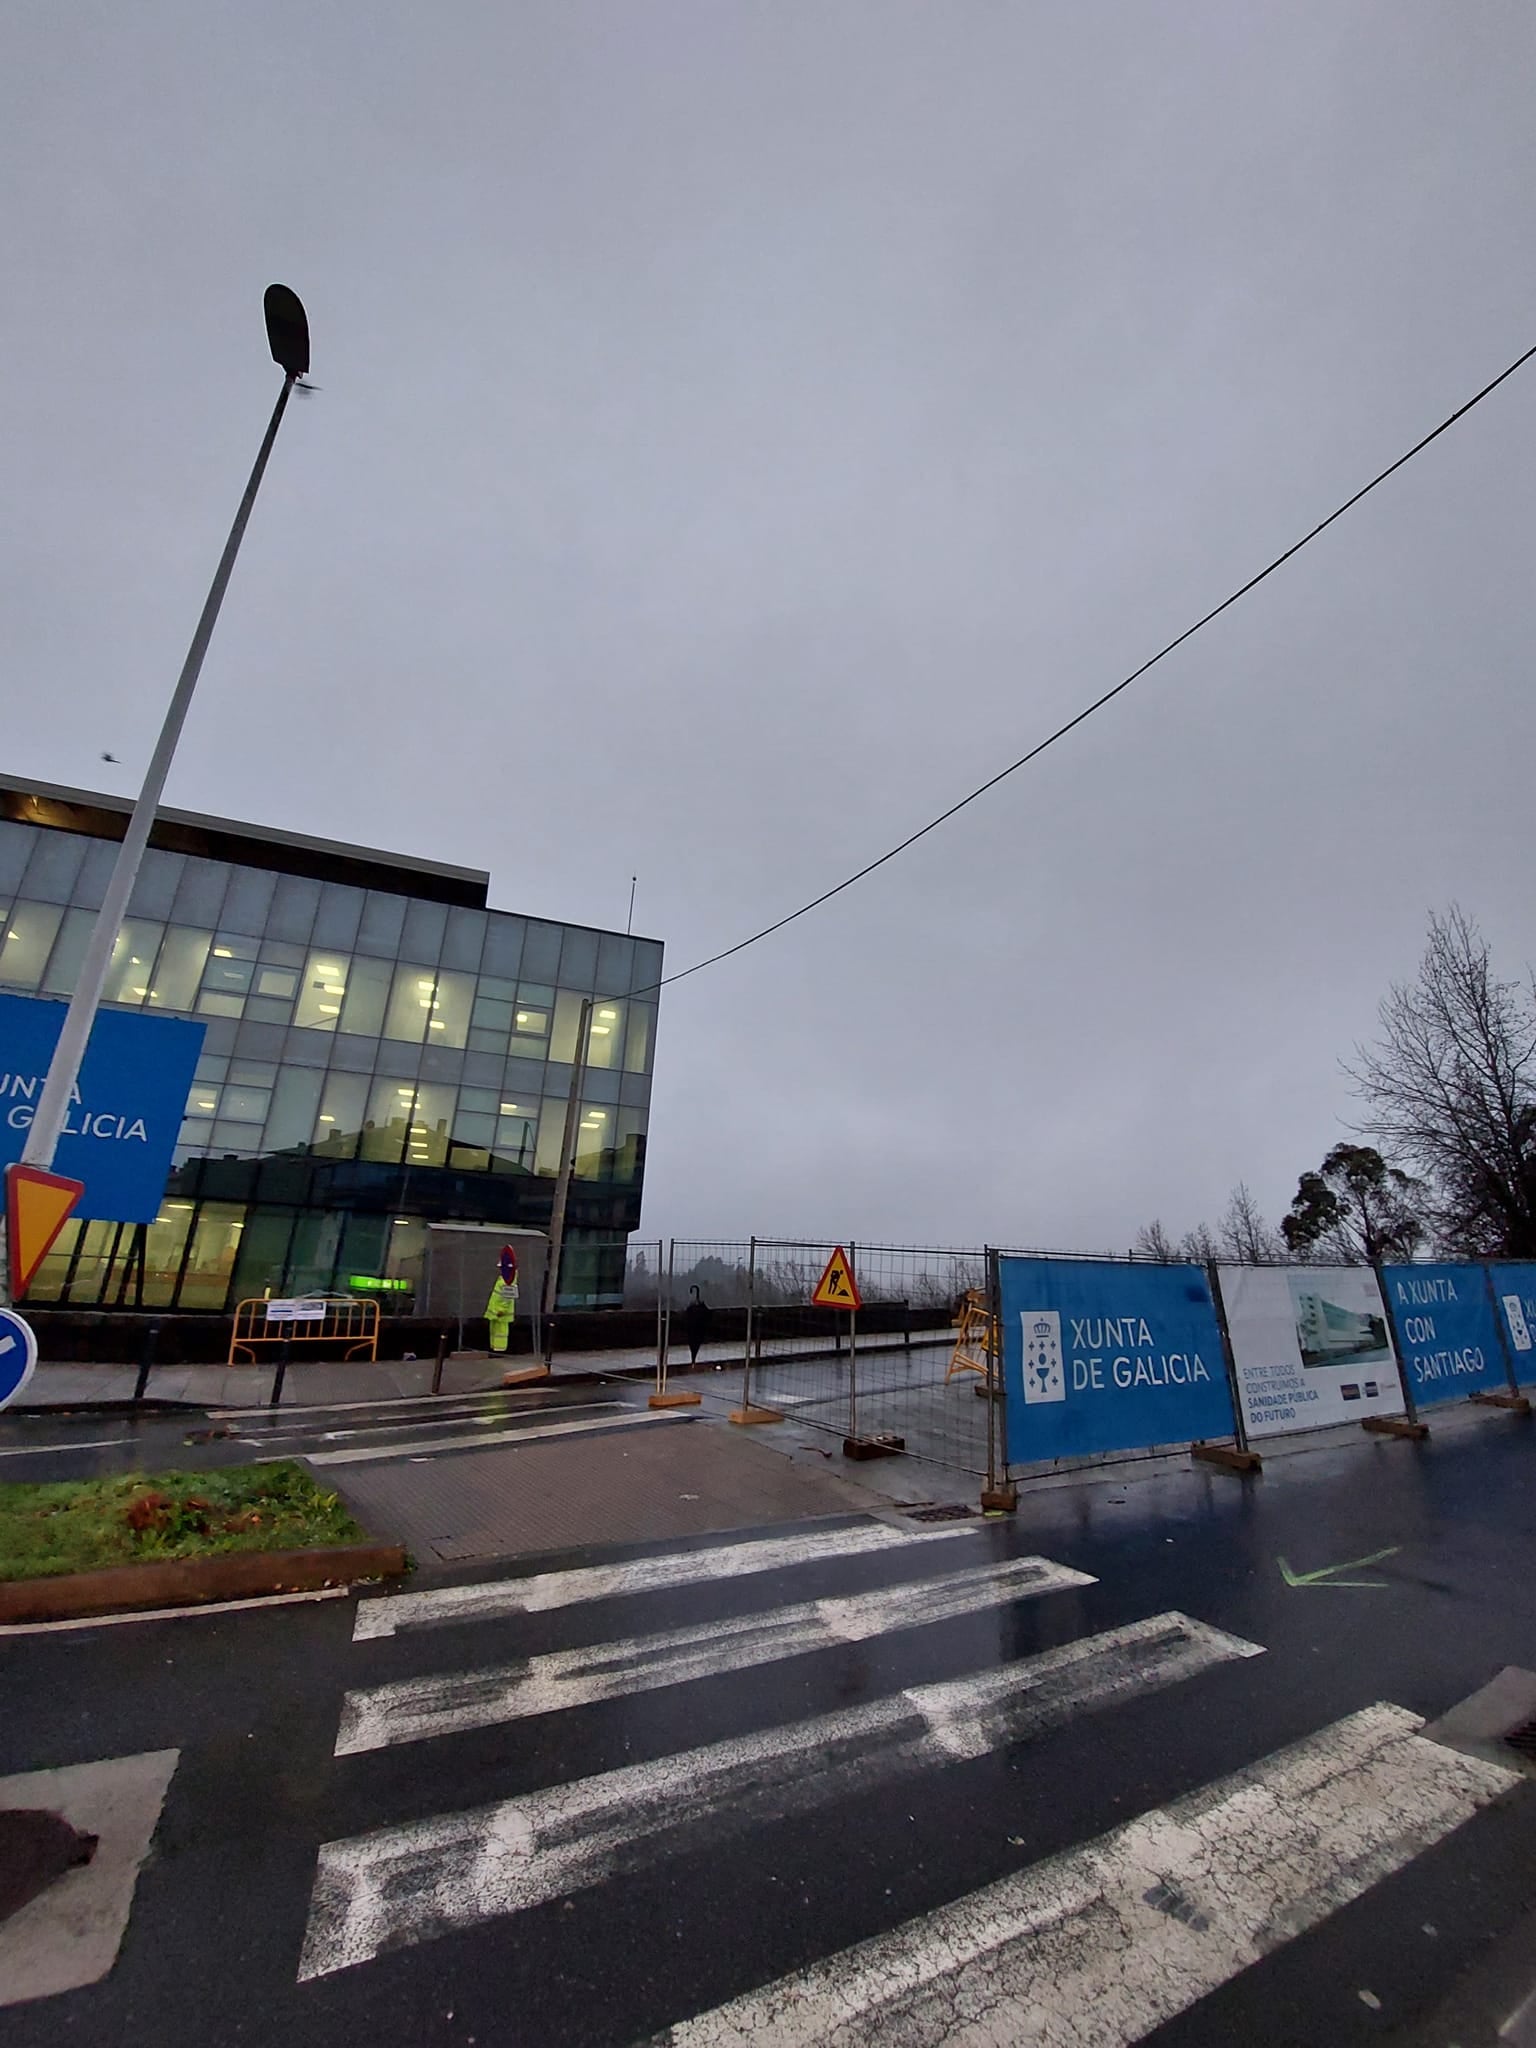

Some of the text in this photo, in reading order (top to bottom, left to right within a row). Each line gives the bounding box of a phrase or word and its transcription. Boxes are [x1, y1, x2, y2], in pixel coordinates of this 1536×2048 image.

[8, 1105, 148, 1142] GLICIA
[1397, 1279, 1458, 1305] A XUNTA
[1070, 1317, 1155, 1350] XUNTA
[1405, 1316, 1437, 1344] CON
[1073, 1353, 1211, 1391] DE GALICIA
[1243, 1366, 1269, 1379] ENTRE
[1413, 1346, 1485, 1383] SANTIAGO
[1248, 1393, 1289, 1409] SANIDADE
[1250, 1407, 1296, 1424] DO FUTURO
